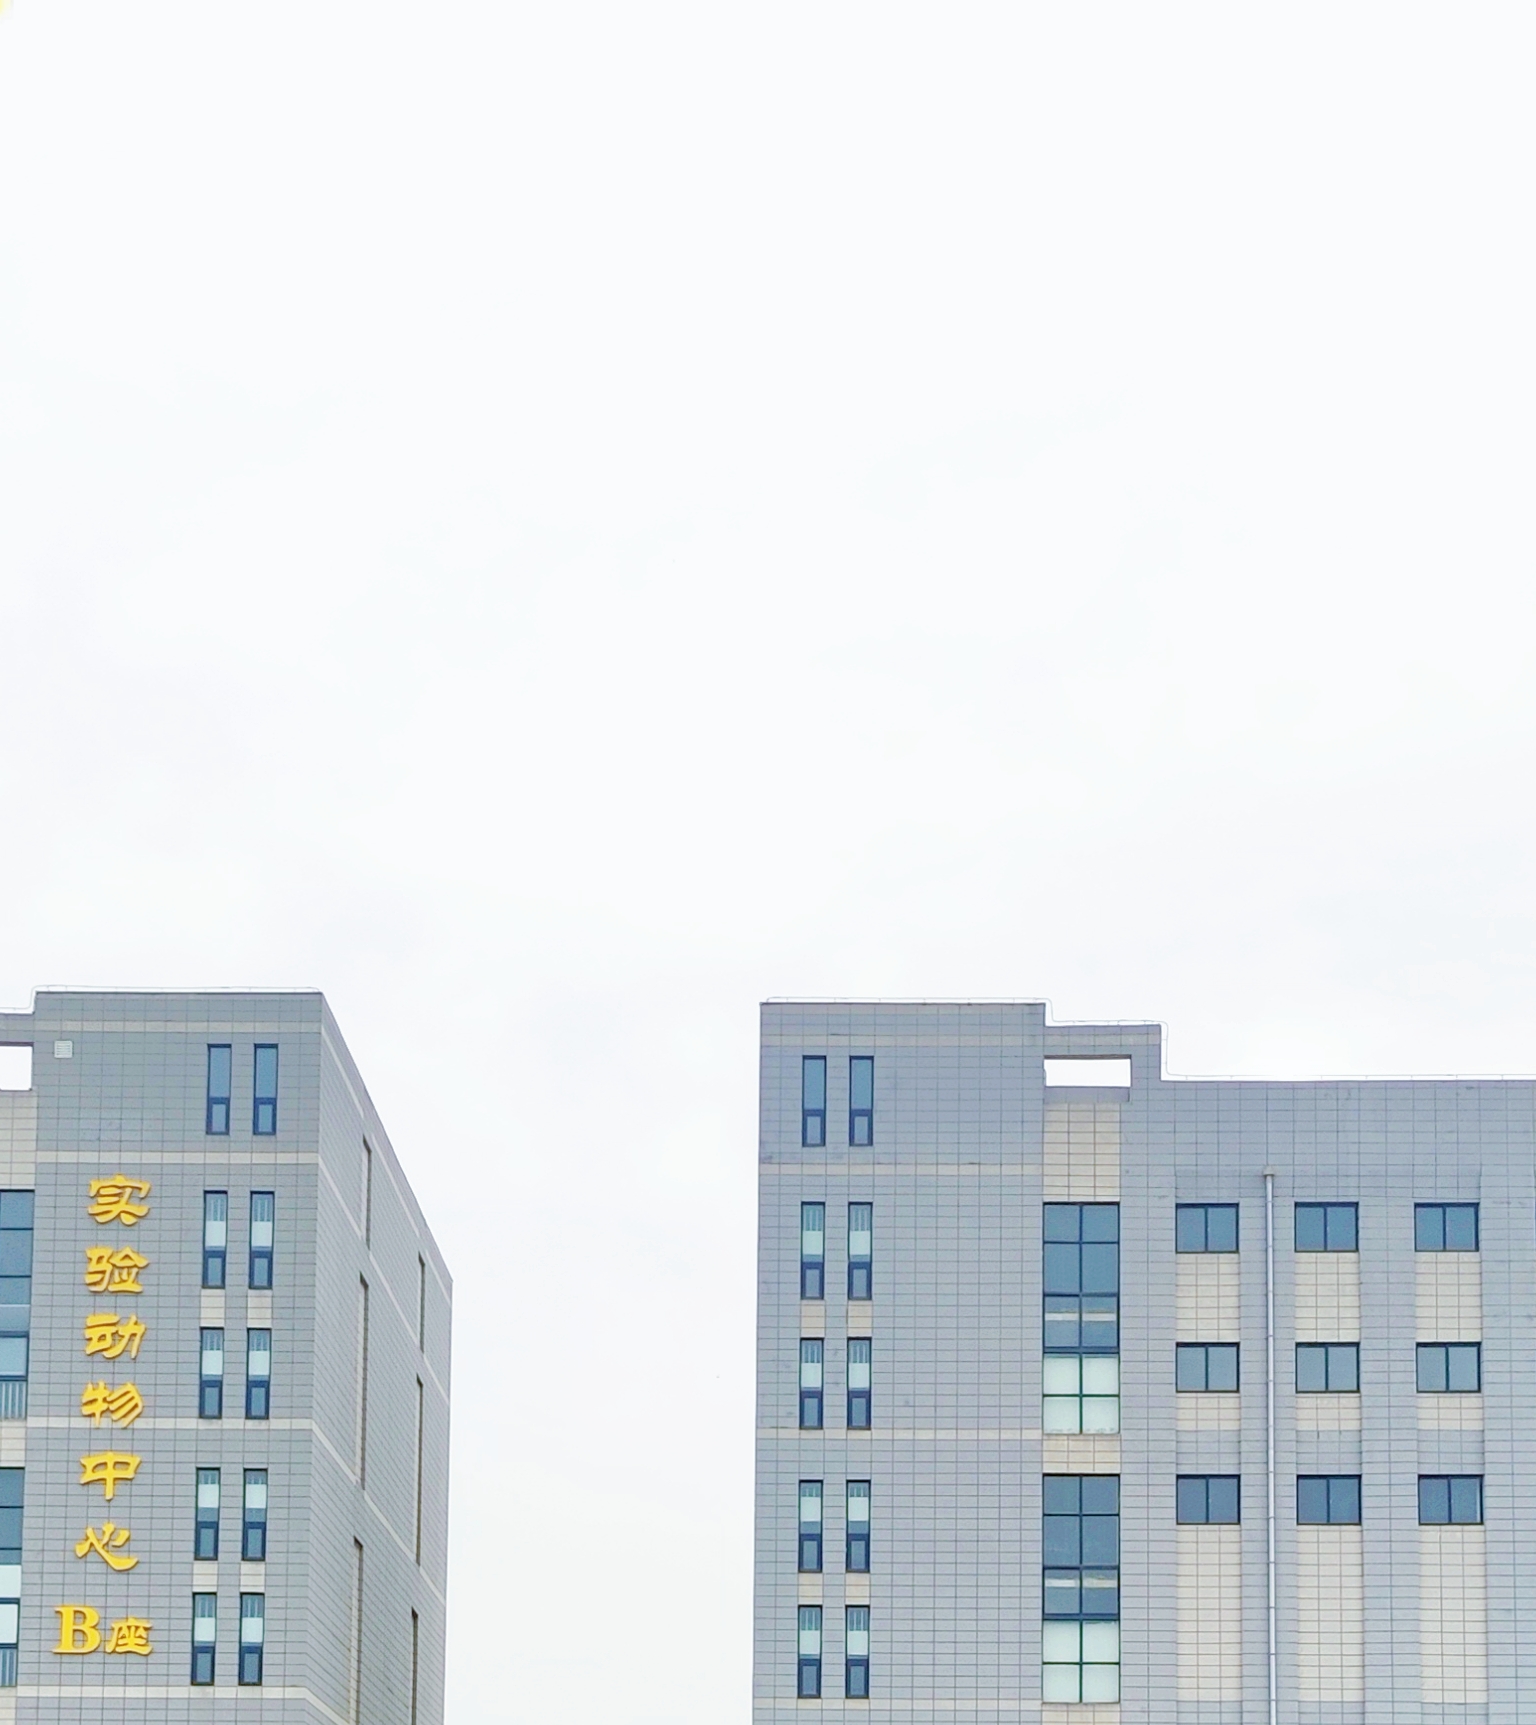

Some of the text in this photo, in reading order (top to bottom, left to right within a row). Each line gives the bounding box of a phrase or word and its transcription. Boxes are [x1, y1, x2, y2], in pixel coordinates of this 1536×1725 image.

[74, 1173, 151, 1572] 实验动物中心
[52, 1603, 154, 1657] B座
